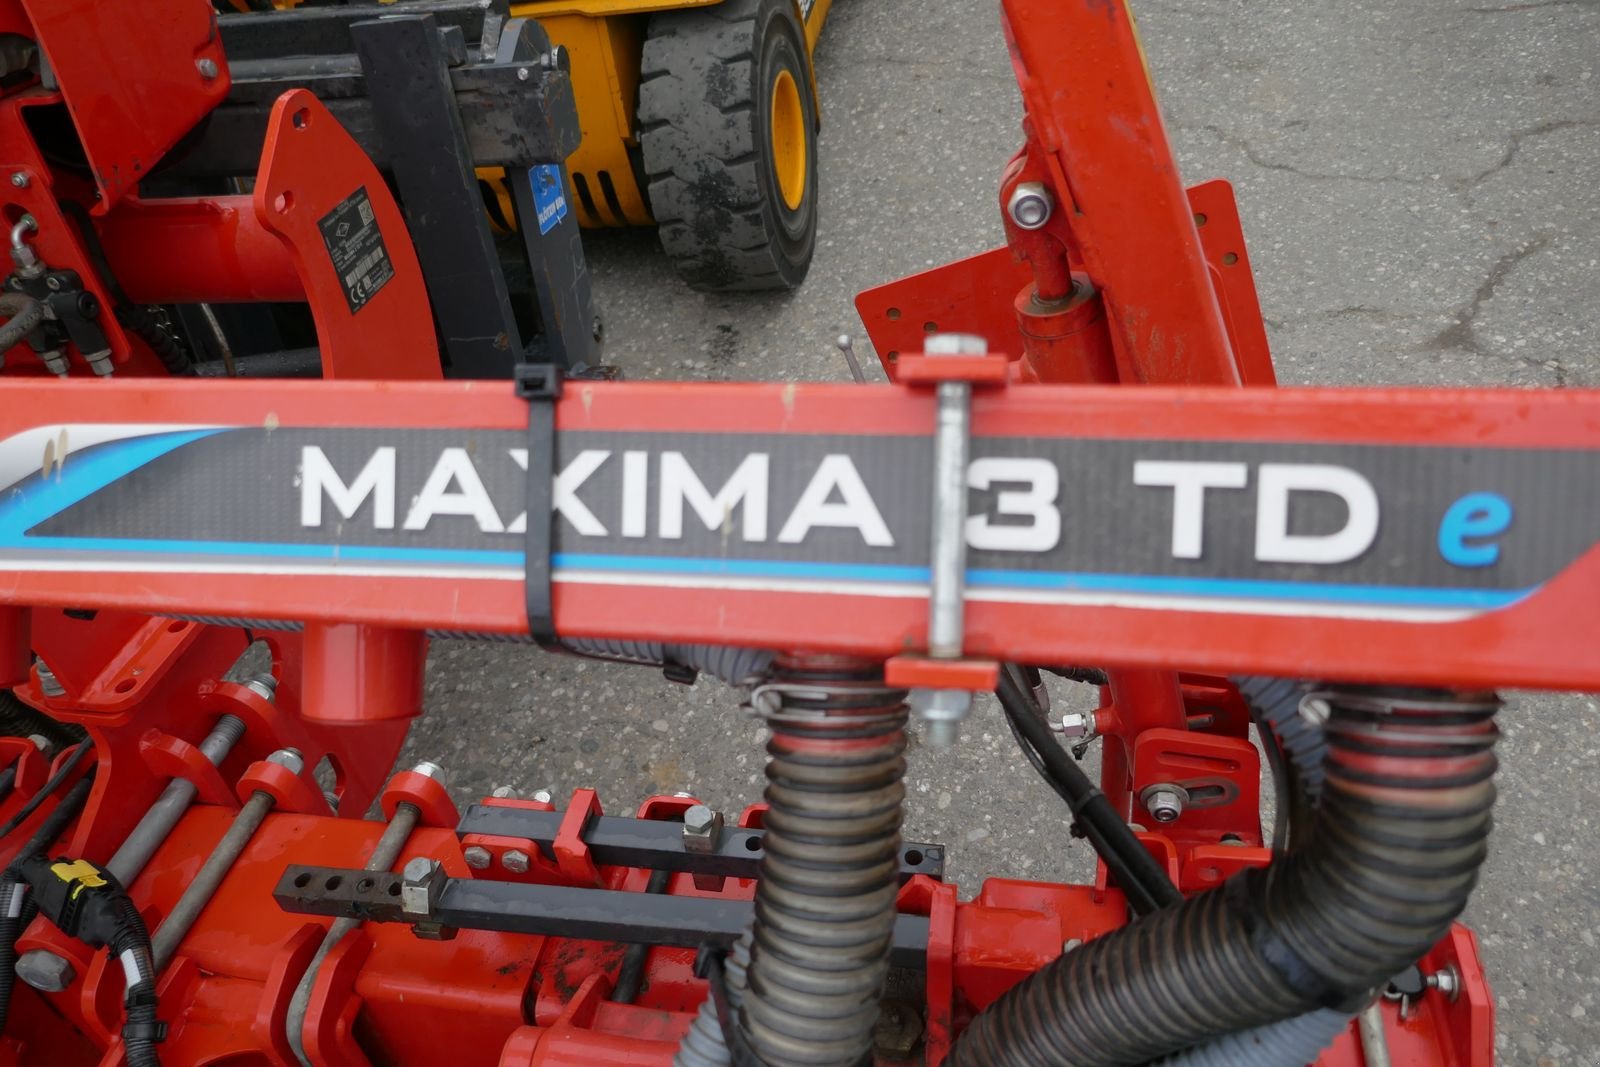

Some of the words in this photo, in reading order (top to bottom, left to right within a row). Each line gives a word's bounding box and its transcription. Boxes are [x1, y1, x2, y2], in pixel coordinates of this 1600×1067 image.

[300, 445, 894, 547] MAXIMA
[965, 457, 1062, 552] 3
[1132, 461, 1380, 564] TD
[1438, 491, 1513, 568] e
